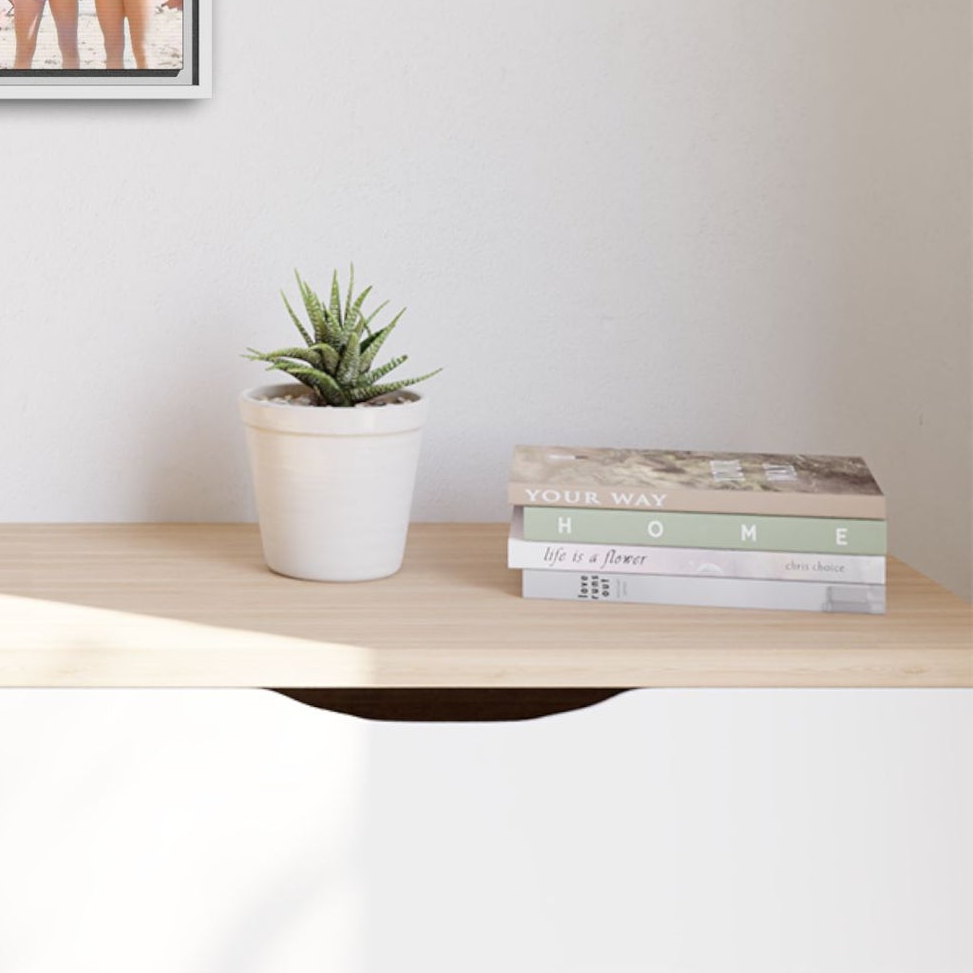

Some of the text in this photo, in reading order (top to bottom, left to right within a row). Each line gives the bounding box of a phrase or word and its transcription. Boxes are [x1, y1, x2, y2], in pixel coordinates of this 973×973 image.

[525, 489, 667, 506] YOUR WAY
[543, 546, 648, 569] life is a flower
[785, 559, 846, 573] chris choice
[577, 575, 588, 598] love
[591, 575, 599, 599] runs
[601, 578, 610, 597] out
